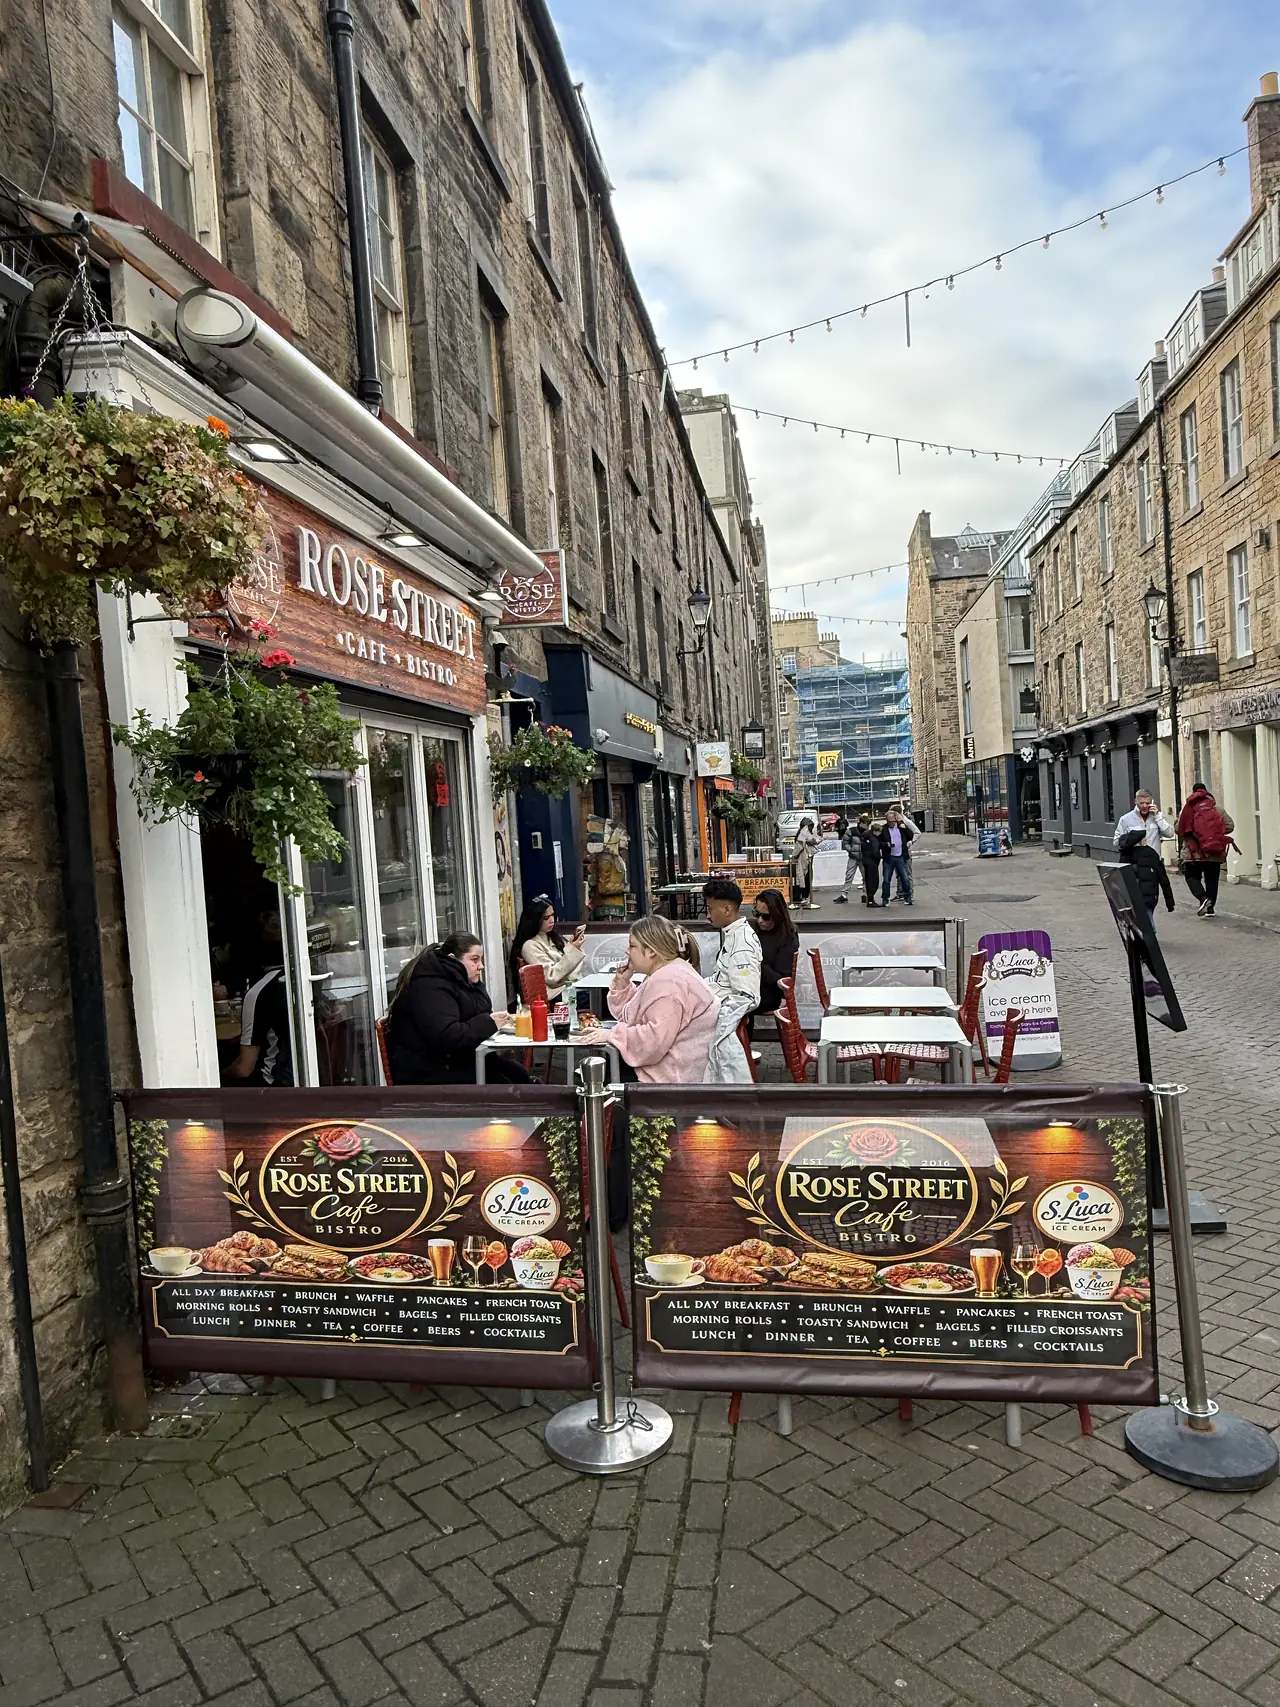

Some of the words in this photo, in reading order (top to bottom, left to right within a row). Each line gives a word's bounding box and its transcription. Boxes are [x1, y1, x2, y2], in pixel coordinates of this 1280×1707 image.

[299, 525, 387, 623] ROSE
[392, 578, 476, 661] STREET
[499, 583, 555, 602] ROSE
[346, 632, 387, 665] CAFE
[407, 653, 453, 686] BISTRO
[744, 878, 788, 886] BREAKFAST
[996, 952, 1036, 968] S.Luca
[988, 996, 1007, 1006] ice
[1010, 992, 1051, 1004] cream
[269, 1168, 332, 1198] ROSE
[338, 1168, 424, 1194] STREET
[788, 1172, 862, 1203] ROSE
[868, 1172, 968, 1200] STREET
[310, 1194, 385, 1224] Cafe
[488, 1194, 550, 1216] S.Luca
[834, 1200, 922, 1232] Cafe
[1040, 1200, 1112, 1223] S.Luca
[316, 1226, 382, 1236] BISTRO
[498, 1218, 512, 1226] ICE
[840, 1232, 916, 1243] BISTRO
[1074, 1277, 1114, 1291] S.Luca
[172, 1288, 191, 1297] ALL
[195, 1289, 216, 1297] DAY
[220, 1289, 276, 1298] BREAKFAST
[295, 1291, 337, 1301] BRUNCH
[356, 1294, 394, 1304] WAFFLE
[416, 1296, 468, 1306] PANCAKES
[486, 1299, 527, 1308] FRENCH
[530, 1299, 562, 1310] TOAST
[176, 1302, 224, 1311] MORNING
[229, 1304, 261, 1312] ROLLS
[281, 1306, 320, 1315] TOASTY
[323, 1306, 376, 1317] SANDWICH
[399, 1310, 438, 1320] BAGELS
[460, 1313, 495, 1322] FILLED
[498, 1314, 562, 1324] CROISSANTS
[668, 1300, 690, 1309] ALL
[695, 1300, 719, 1310] DAY
[724, 1302, 790, 1311] BREAKFAST
[814, 1302, 862, 1313] BRUNCH
[885, 1306, 930, 1316] WAFFLE
[956, 1308, 1016, 1318] PANCAKES
[1036, 1310, 1083, 1320] FRENCH
[1086, 1311, 1124, 1321] TOAST
[192, 1316, 230, 1326] LUNCH
[254, 1318, 296, 1328] DINNER
[323, 1322, 342, 1330] TEA
[363, 1324, 403, 1334] COFFEE
[428, 1326, 461, 1336] BEERS
[484, 1328, 546, 1339] COCKTAILS
[672, 1315, 730, 1324] MORNING
[735, 1316, 772, 1325] ROLLS
[797, 1318, 842, 1328] TOASTY
[846, 1318, 909, 1330] SANDWICH
[936, 1322, 980, 1332] BAGELS
[1006, 1324, 1046, 1334] FILLED
[1050, 1326, 1124, 1337] CROISSANTS
[692, 1330, 736, 1340] LUNCH
[765, 1332, 816, 1342] DINNER
[846, 1335, 870, 1344] TEA
[894, 1336, 941, 1347] COFFEE
[969, 1339, 1008, 1350] BEERS
[1034, 1342, 1104, 1352] COCKTAILS
